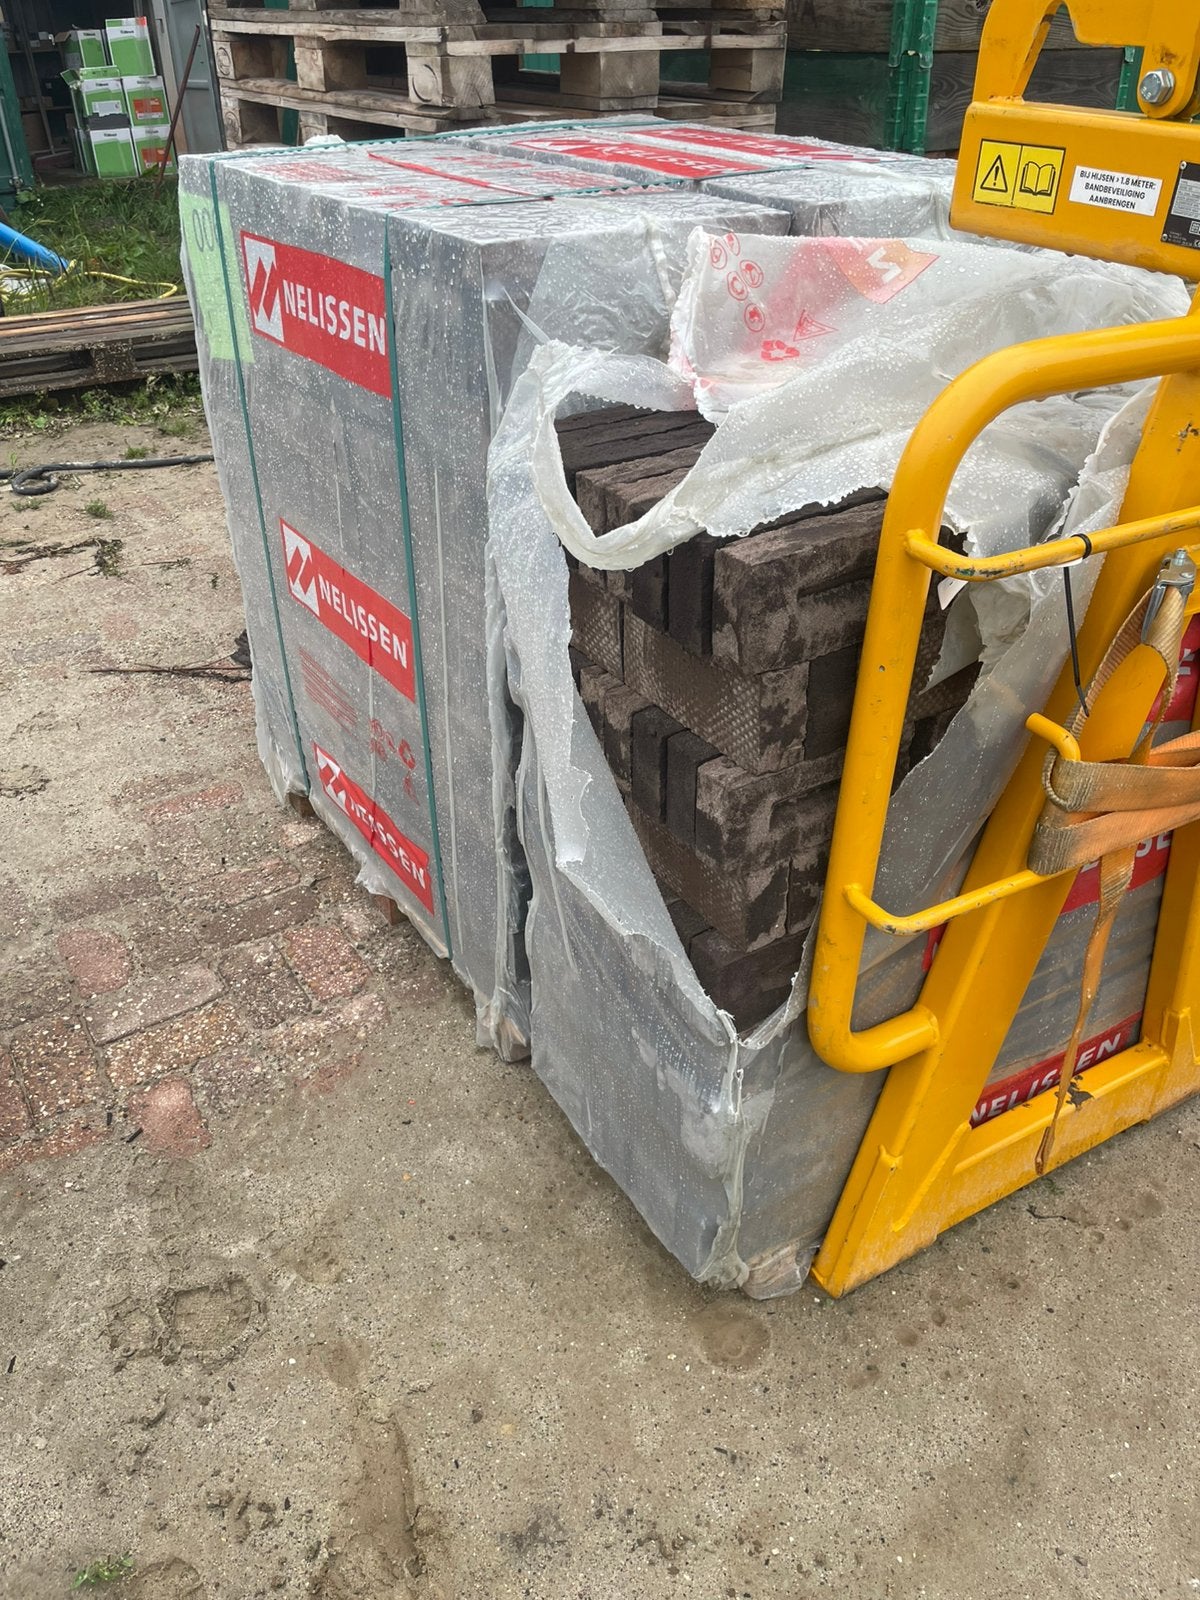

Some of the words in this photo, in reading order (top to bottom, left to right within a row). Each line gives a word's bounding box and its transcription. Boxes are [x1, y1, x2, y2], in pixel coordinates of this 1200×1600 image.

[1080, 170, 1091, 179] BIJ
[1091, 172, 1115, 183] HIJSEN
[1084, 182, 1146, 200] BANDBEVEILIGING
[1089, 194, 1136, 210] AANBRENGEN
[282, 279, 386, 356] NELISSEN
[318, 573, 408, 669] NELISSEN
[972, 1033, 1121, 1121] NELISEN
